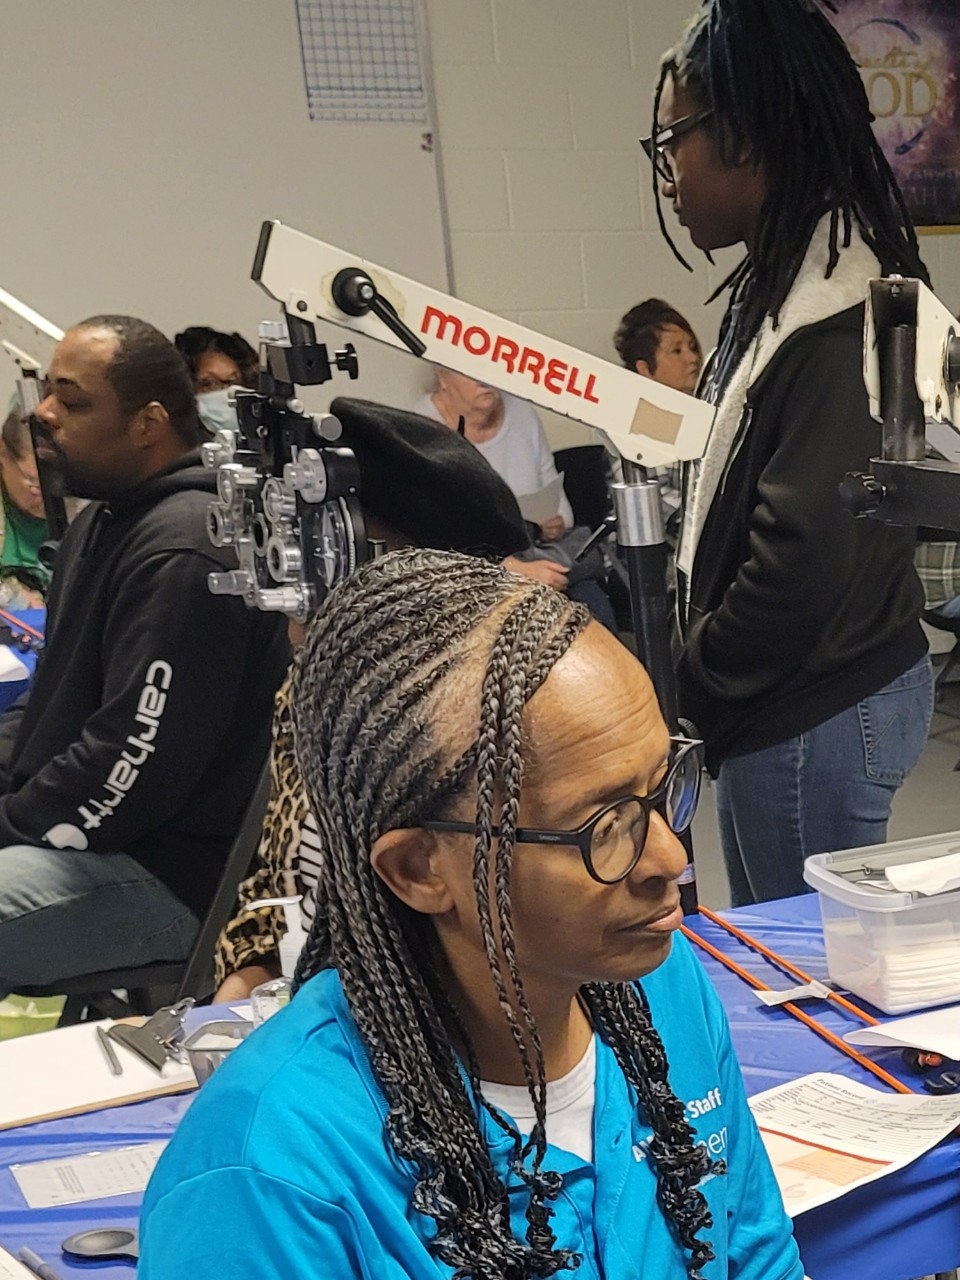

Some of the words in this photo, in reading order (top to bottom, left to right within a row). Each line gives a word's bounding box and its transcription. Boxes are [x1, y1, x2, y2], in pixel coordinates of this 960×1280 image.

[867, 71, 938, 118] OD
[420, 305, 600, 404] MORRELL
[77, 659, 173, 830] carhartt
[687, 1087, 722, 1119] Staff
